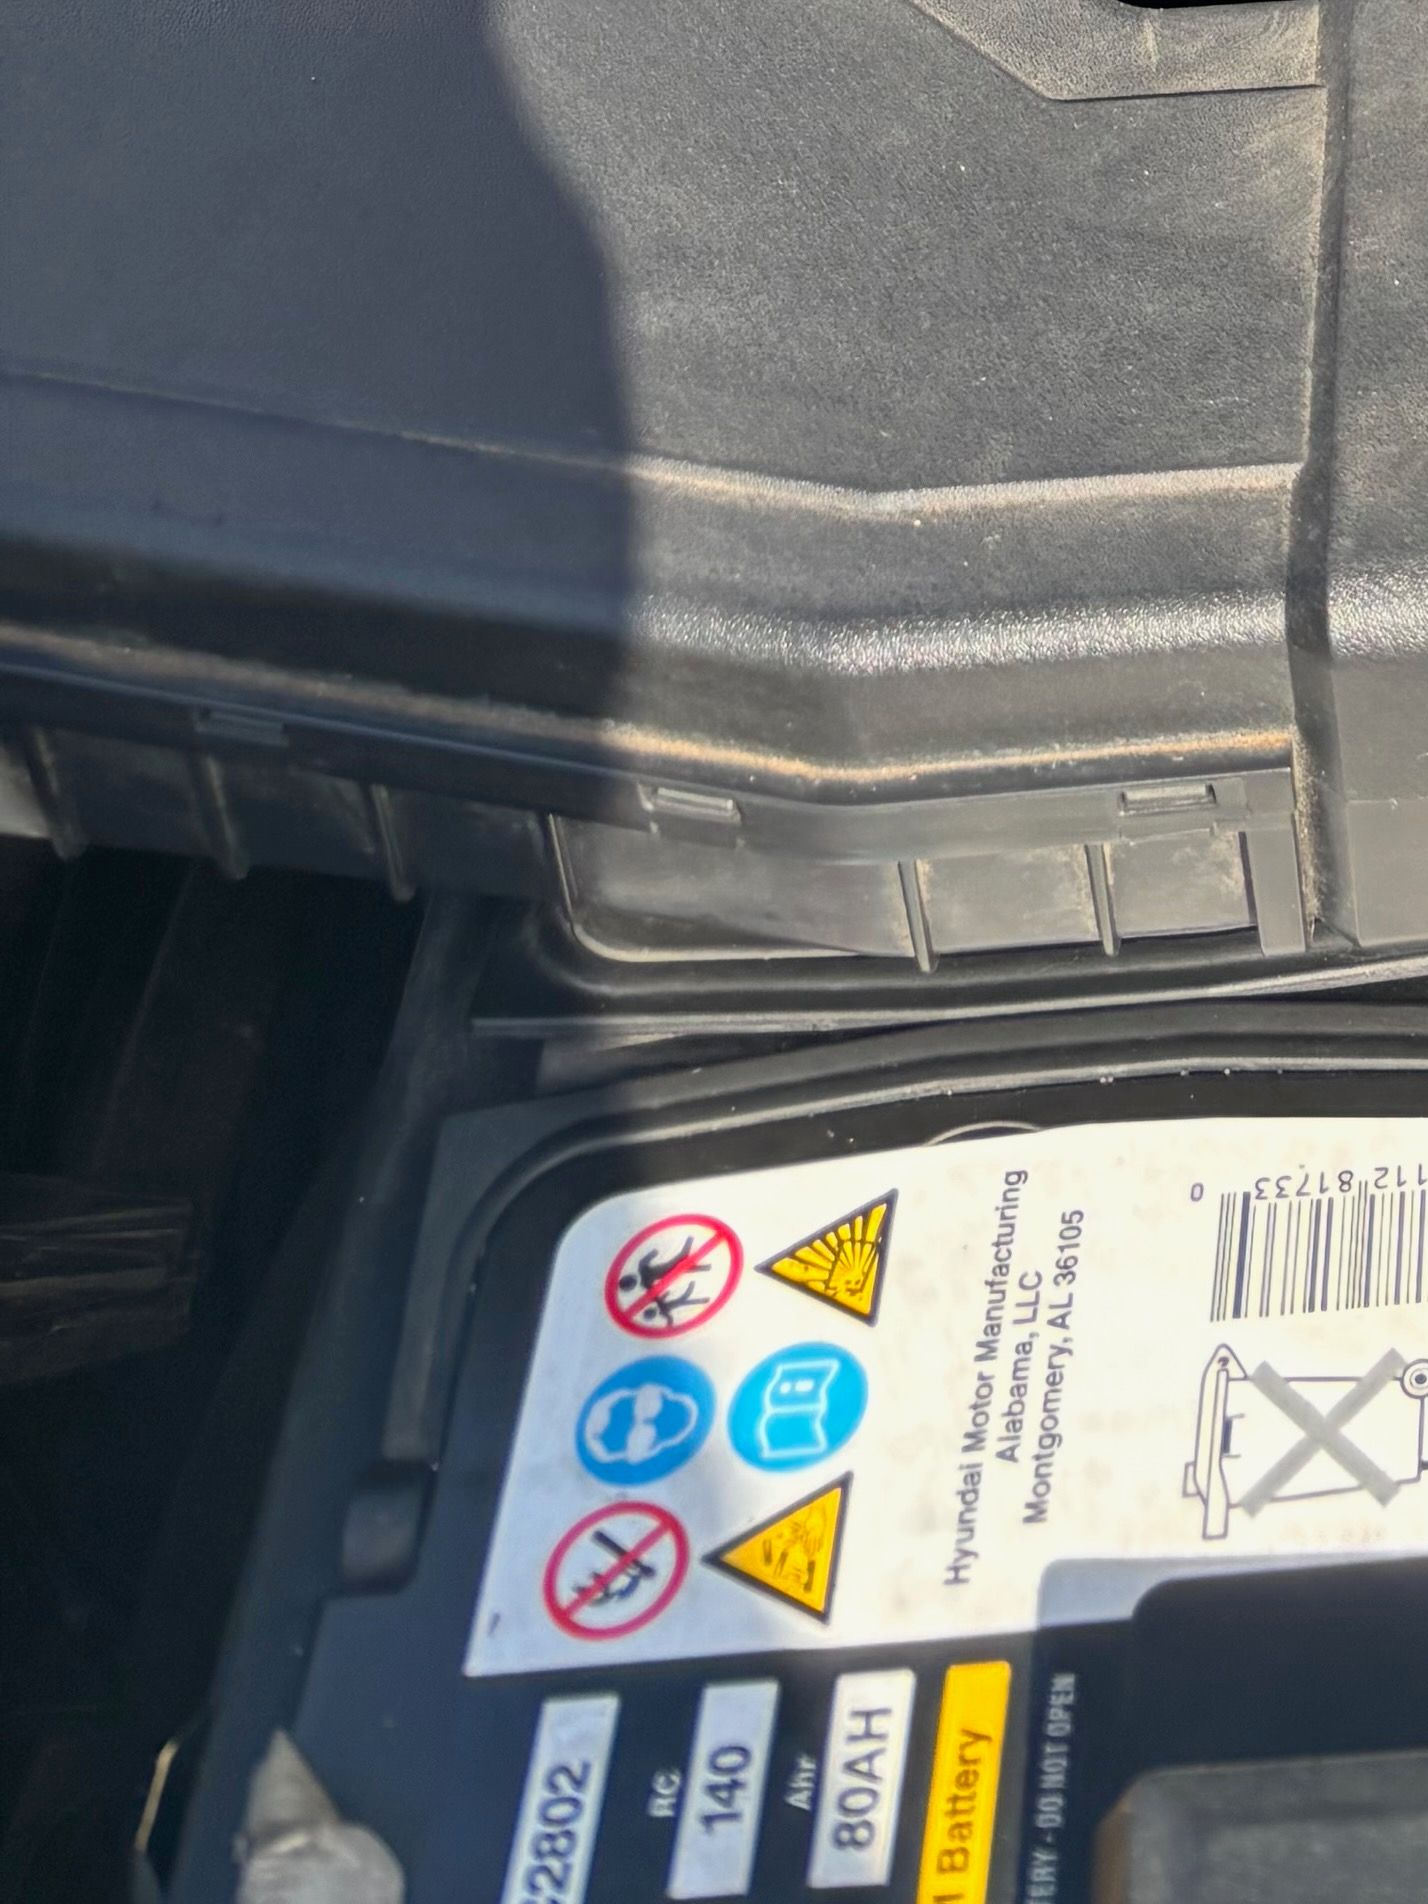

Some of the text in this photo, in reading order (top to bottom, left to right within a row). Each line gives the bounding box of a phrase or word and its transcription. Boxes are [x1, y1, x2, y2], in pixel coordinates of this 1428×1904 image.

[1189, 1181, 1205, 1203] 0
[1254, 1169, 1355, 1201] 81733
[943, 1168, 1029, 1587] Hyundai Motor Manufacturing
[996, 1269, 1043, 1464] Alabama, LLC
[1023, 1208, 1085, 1525] Montgomery, AL 36105
[1047, 1673, 1077, 1738] OPEN
[647, 1768, 681, 1818] RC
[701, 1744, 751, 1835] 140
[784, 1753, 818, 1811] Ahr
[832, 1706, 893, 1851] 80AH
[1040, 1745, 1071, 1789] NOT
[935, 1728, 994, 1875] Battery
[1035, 1792, 1065, 1829] DO
